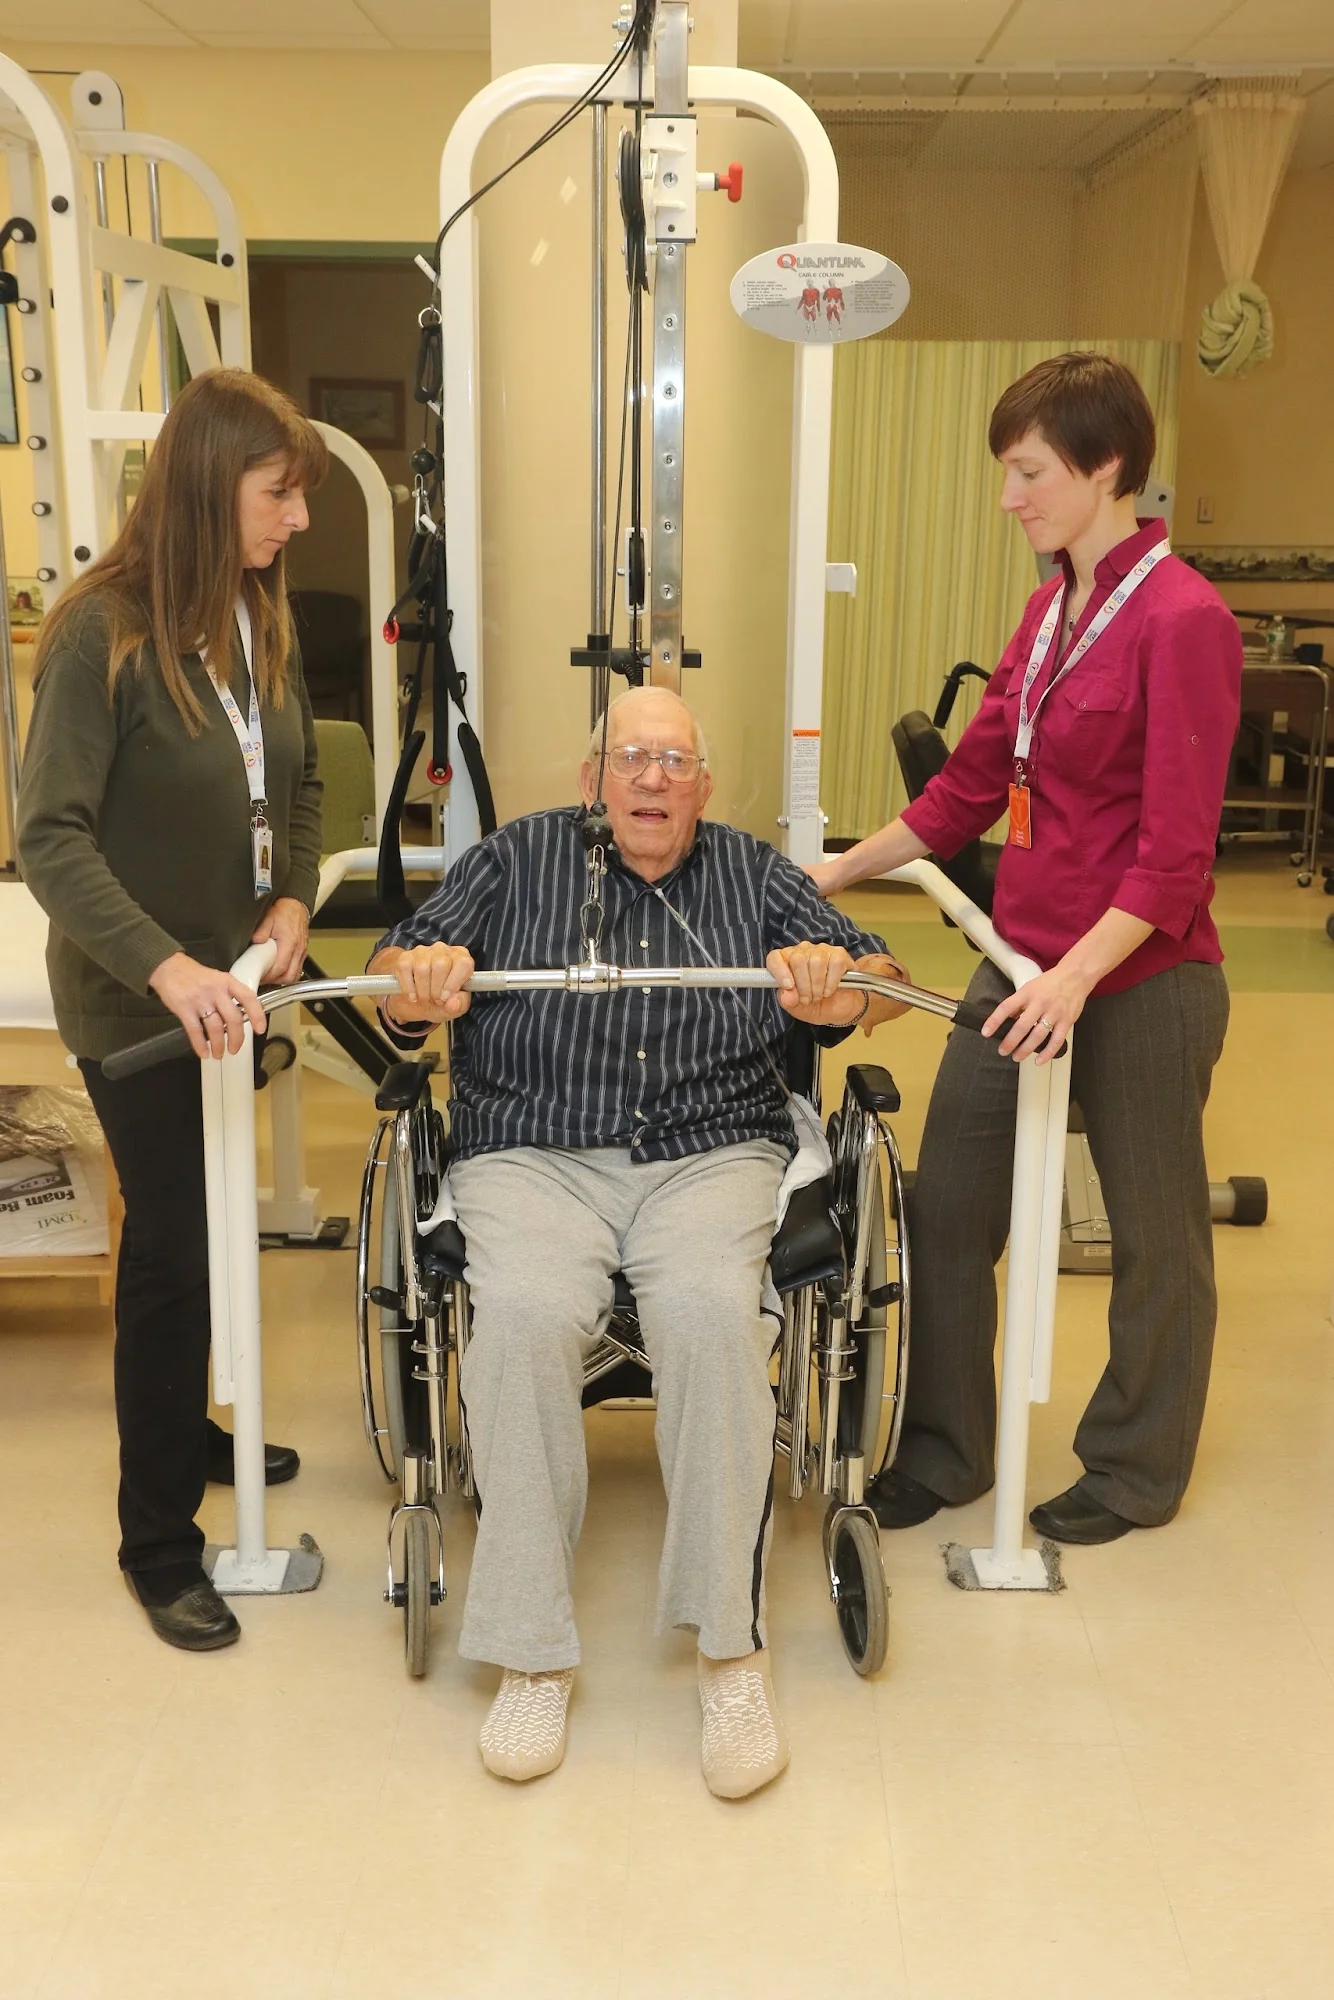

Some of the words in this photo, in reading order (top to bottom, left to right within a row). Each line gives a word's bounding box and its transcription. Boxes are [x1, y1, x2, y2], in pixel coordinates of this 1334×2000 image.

[667, 246, 675, 256] 2
[777, 253, 866, 273] QUANTUM
[665, 317, 673, 328] 3
[665, 387, 673, 396] 4
[665, 454, 673, 465] 5
[664, 521, 671, 531] 6
[664, 587, 671, 597] 7
[1117, 594, 1127, 605] CARE
[663, 651, 670, 661] 8
[25, 1189, 76, 1206] Foam
[37, 1213, 74, 1229] DMI
